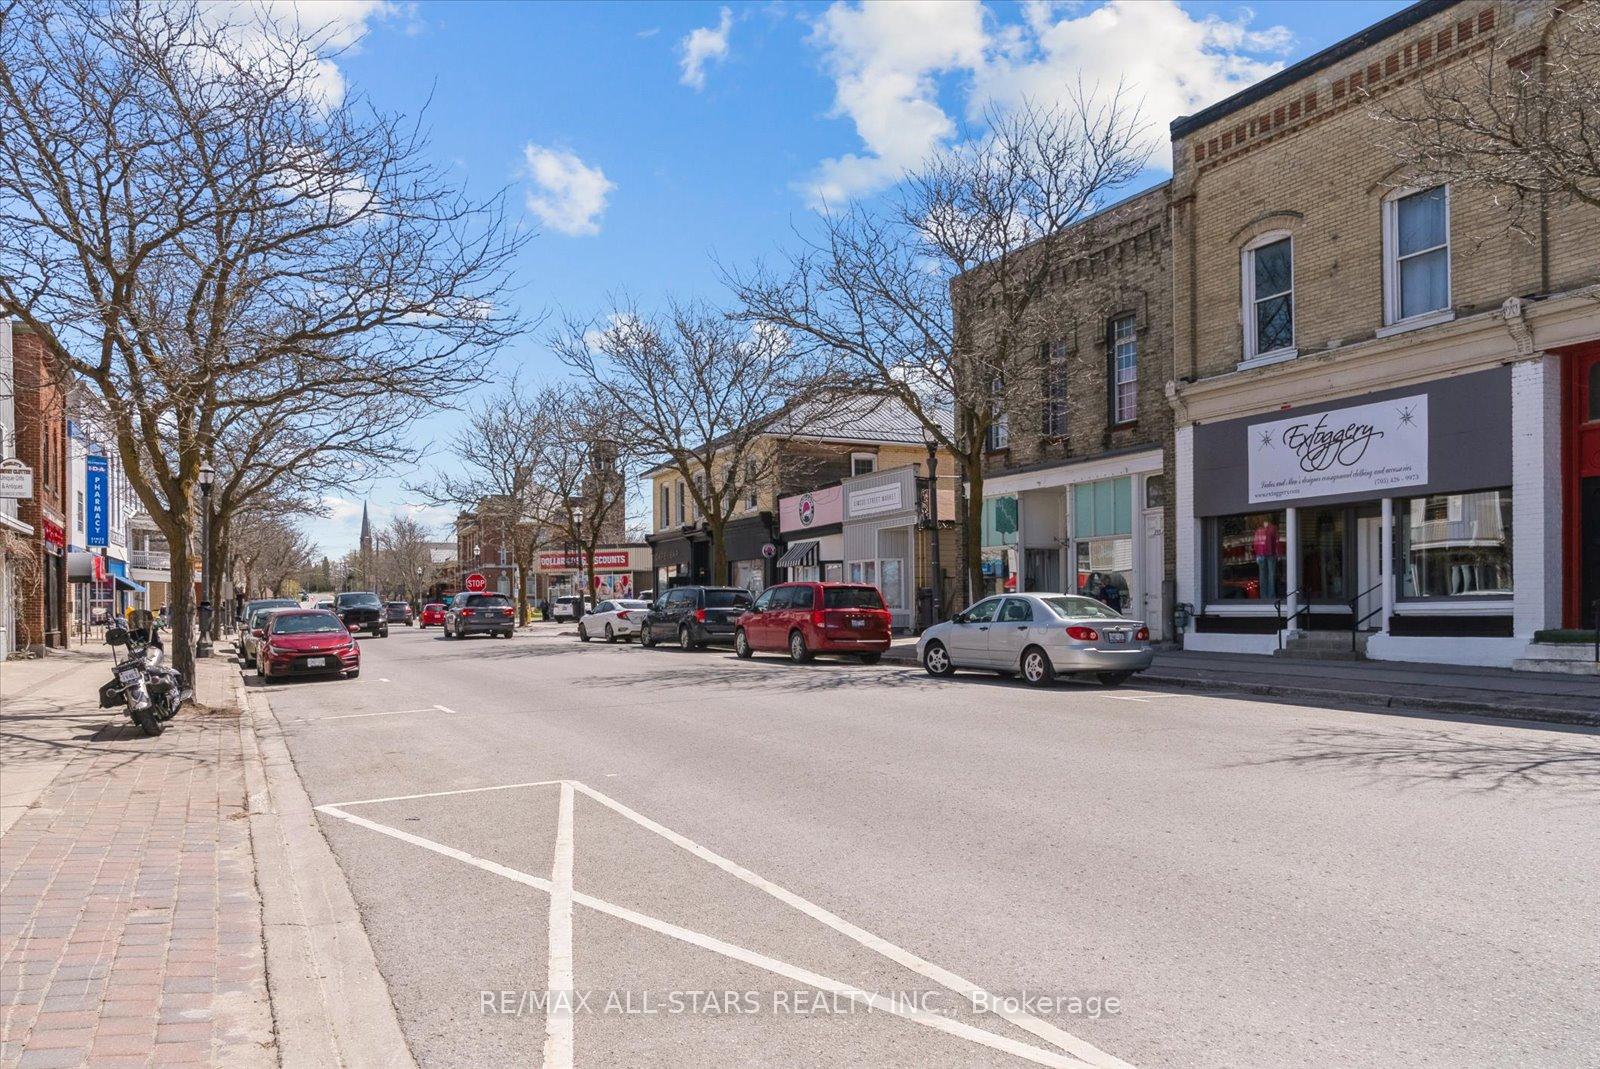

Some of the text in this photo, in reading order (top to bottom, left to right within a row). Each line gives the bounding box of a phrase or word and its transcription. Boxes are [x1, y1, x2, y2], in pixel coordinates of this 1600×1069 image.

[1283, 414, 1384, 472] Extoggery
[541, 557, 565, 566] DOLLAR
[467, 580, 485, 588] STOP
